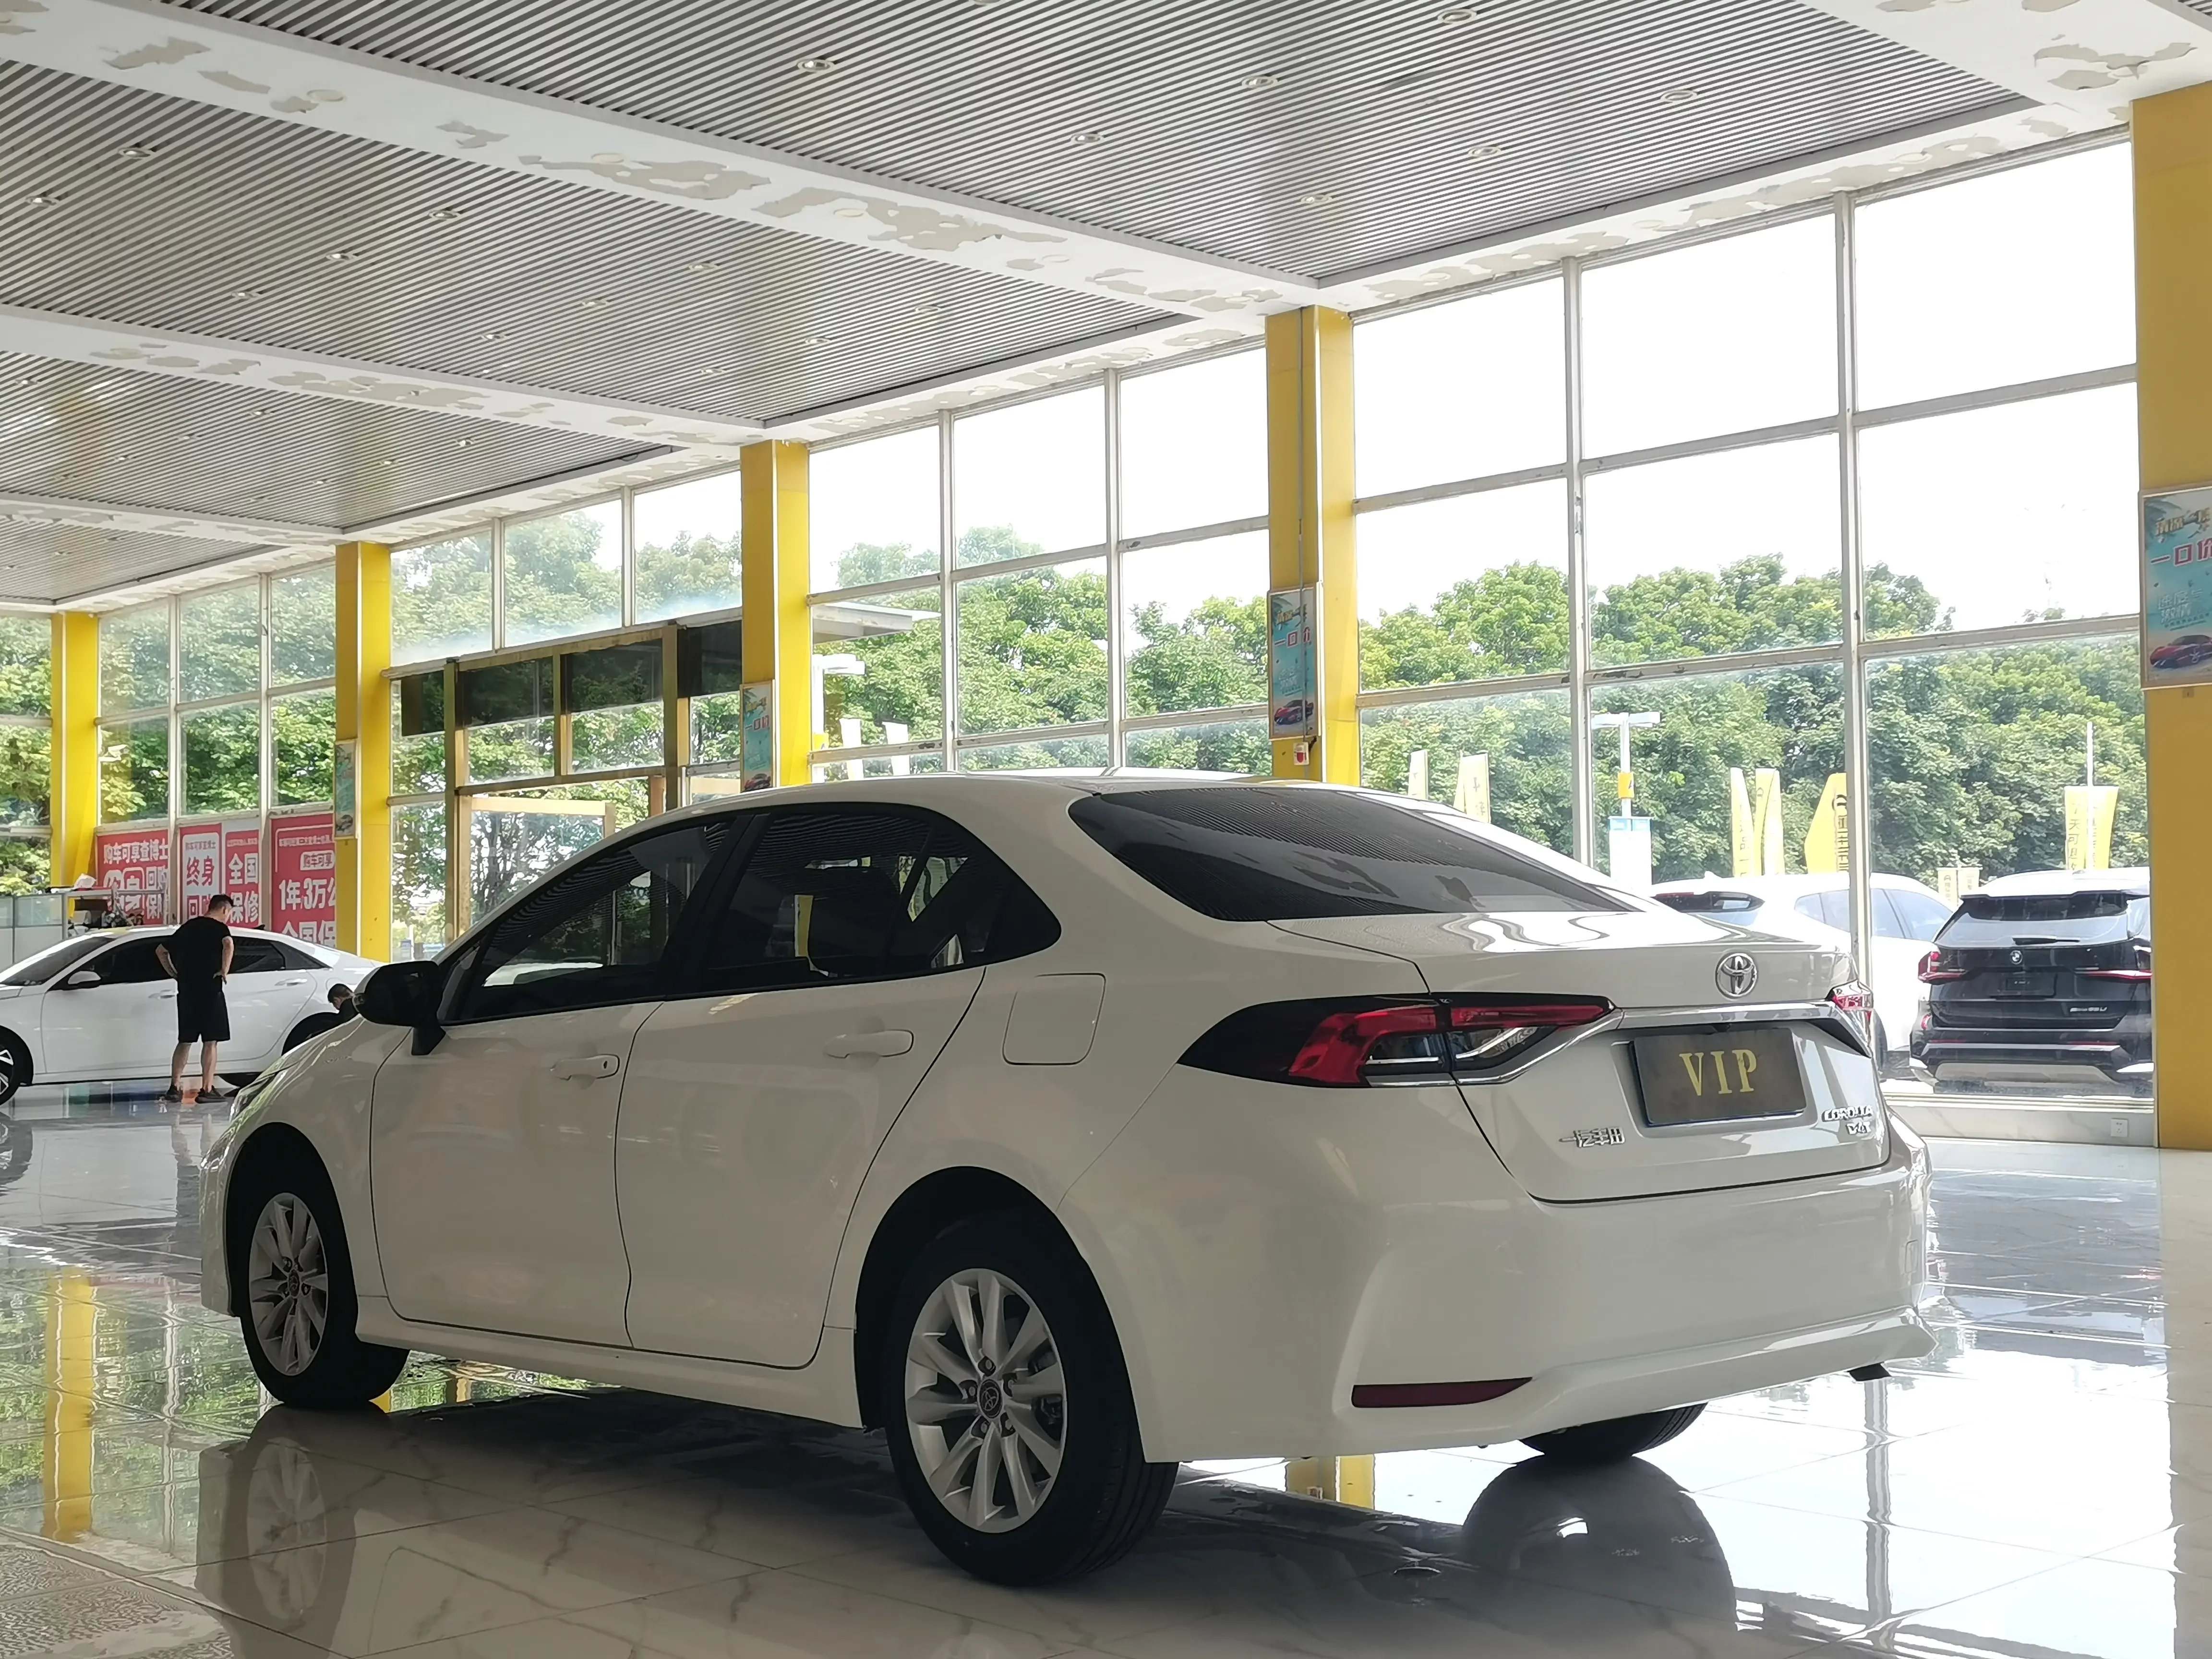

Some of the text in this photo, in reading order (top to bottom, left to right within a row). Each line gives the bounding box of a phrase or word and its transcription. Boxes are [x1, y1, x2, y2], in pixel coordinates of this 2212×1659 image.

[2151, 537, 2212, 566] 一口价
[103, 838, 168, 865] 购车可享查博士
[186, 855, 215, 886] 终身
[228, 853, 258, 885] 全国
[228, 890, 258, 924] 保修
[1679, 1049, 1756, 1095] VIP
[1559, 1127, 1625, 1147] 一汽丰田
